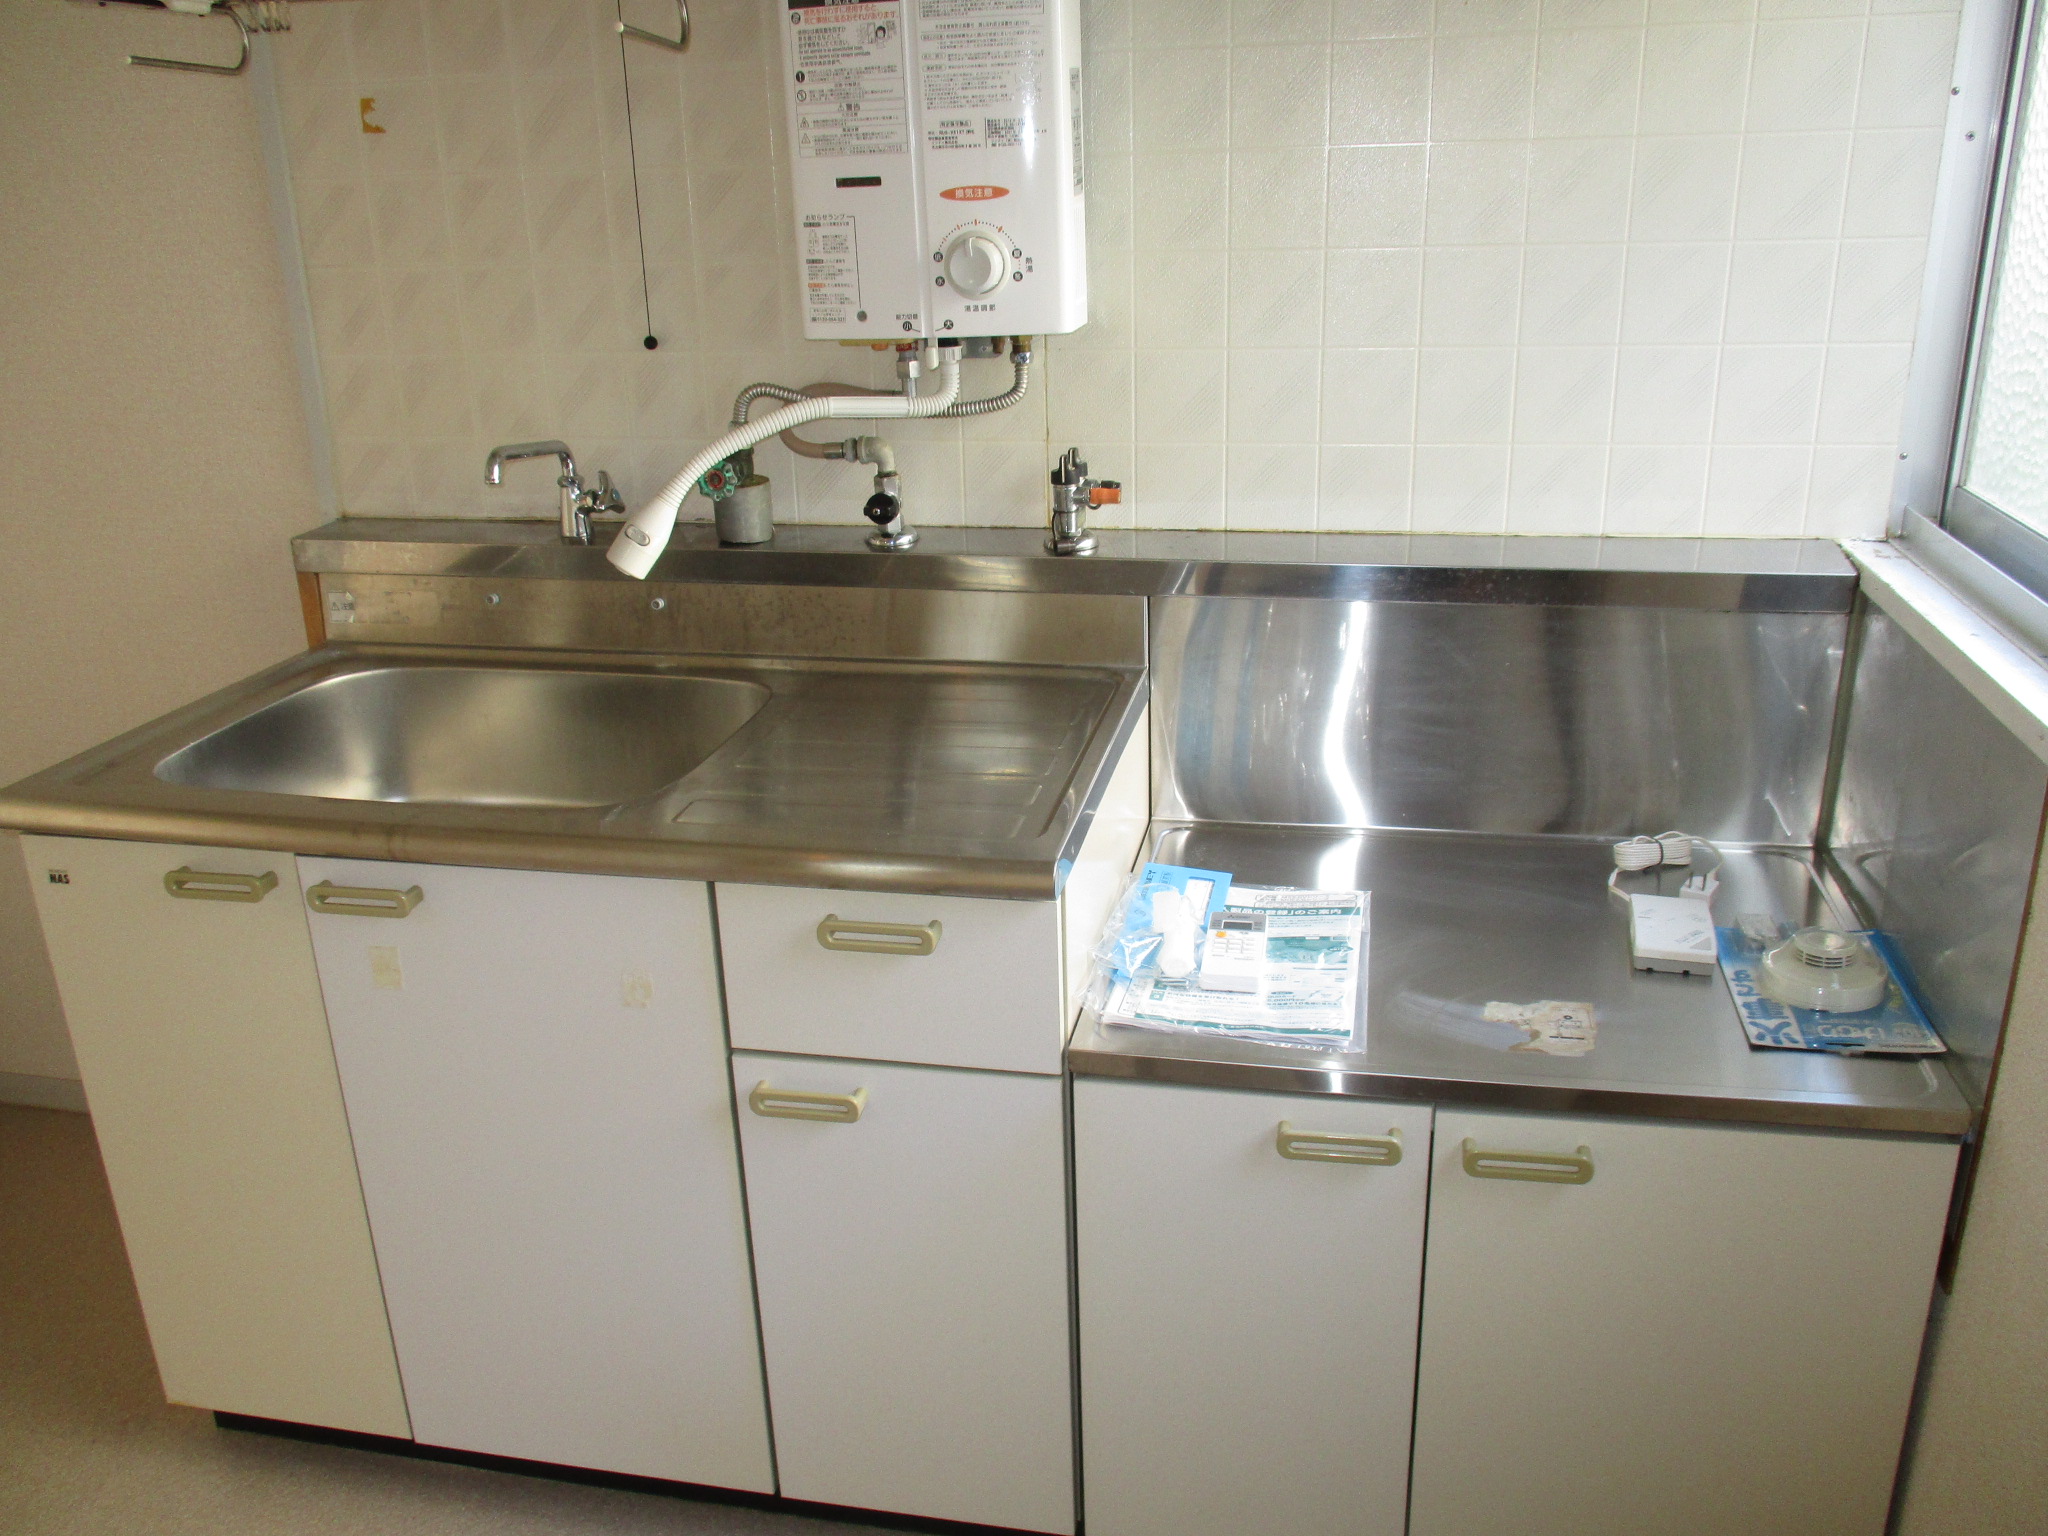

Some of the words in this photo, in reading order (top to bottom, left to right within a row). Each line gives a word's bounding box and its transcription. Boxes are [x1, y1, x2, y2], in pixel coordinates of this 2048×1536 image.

[955, 187, 994, 198] 換気注意
[805, 213, 846, 221] お知らせランプ
